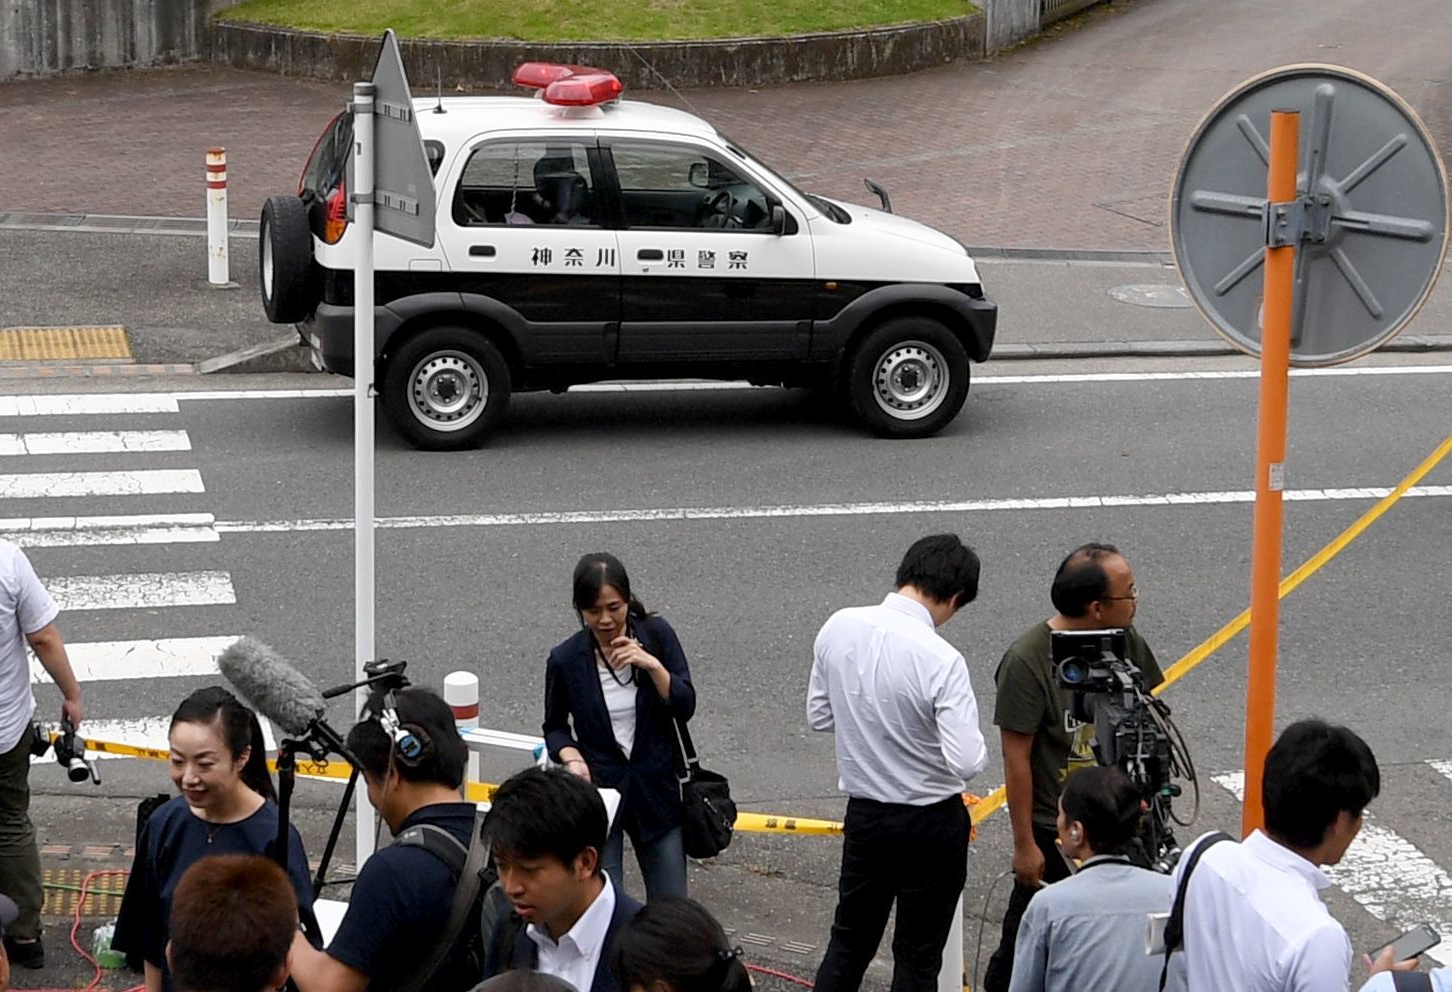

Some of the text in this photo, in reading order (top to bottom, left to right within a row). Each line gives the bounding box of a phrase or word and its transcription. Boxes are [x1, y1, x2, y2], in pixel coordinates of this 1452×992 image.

[531, 247, 748, 270] 神奈川県警察
